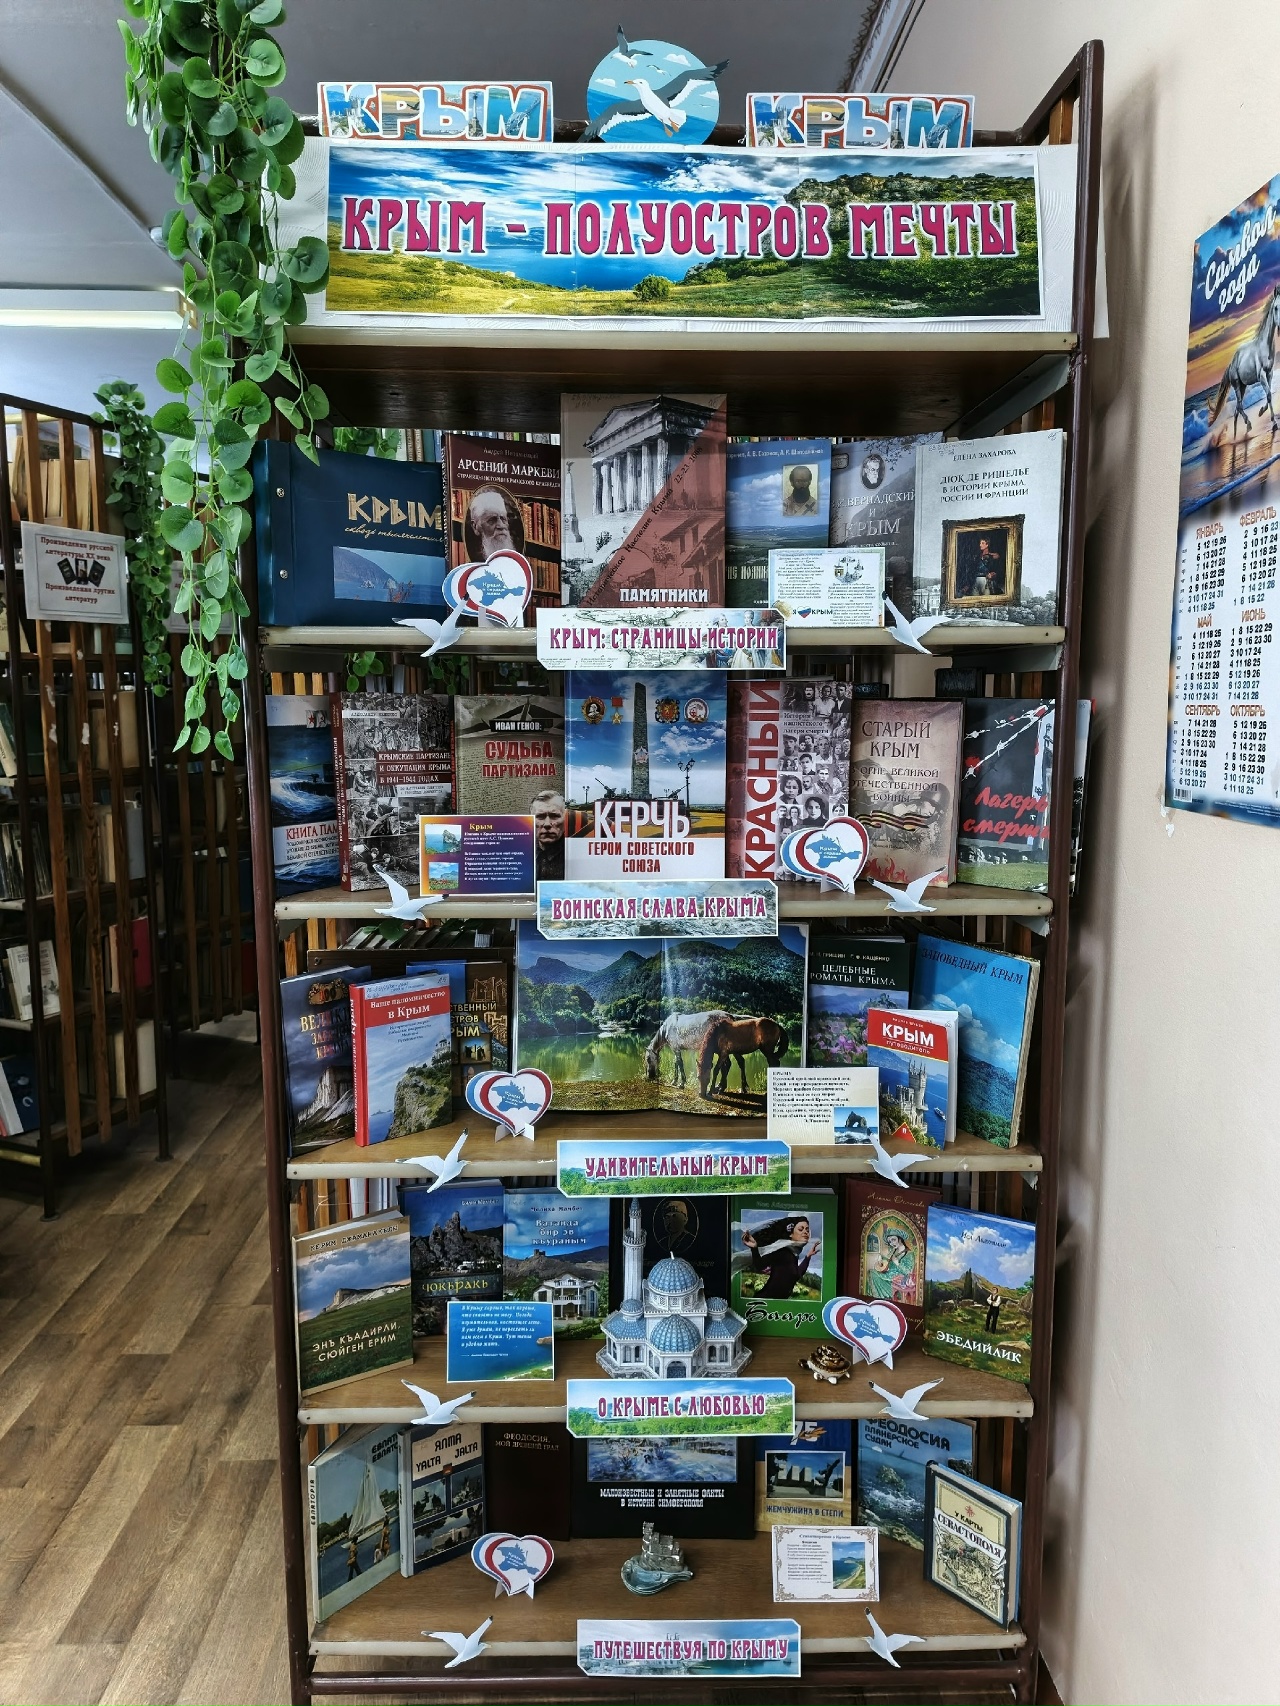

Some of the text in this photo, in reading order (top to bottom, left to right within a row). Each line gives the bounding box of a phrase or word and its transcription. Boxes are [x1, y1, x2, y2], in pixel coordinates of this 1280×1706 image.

[322, 84, 549, 139] КРЫМ
[748, 93, 972, 147] КРЫМ
[342, 197, 1017, 259] КРЫМ ПОЛУОСТРОВ МЕЧТЫ
[1205, 204, 1276, 300] Символ
[1218, 253, 1260, 313] года
[953, 449, 1017, 461] ЕЛЕНА ЗАХАРОВА
[458, 459, 508, 474] АРСЕНИЙ
[940, 468, 1030, 484] ДЮК ДЕ РИШЕЛЬЕ
[940, 494, 974, 503] РОССИИ
[984, 489, 1029, 500] ФРАНЦИИ
[942, 486, 948, 494] В
[949, 482, 991, 493] ИСТОРИИ
[347, 493, 443, 530] КРЫМ
[868, 507, 876, 517] И
[1240, 506, 1277, 527] ФЕВРАЛЬ
[843, 518, 901, 538] КРЫМ
[1196, 522, 1224, 539] ЯНВАРЬ
[620, 589, 708, 602] ПАМЯТНИКИ
[1197, 613, 1213, 628] МАЙ
[1242, 608, 1266, 622] ИЮНЬ
[550, 628, 778, 650] КРЫМ: СТРАНИЦЫ ИСТОРИИ
[1185, 704, 1220, 717] СЕНТЯБРЬ
[1230, 704, 1266, 717] ОКТЯБРЬ
[494, 720, 542, 731] ИВАН ГЕНОВ:
[862, 720, 931, 739] СТАРЫЙ
[1241, 721, 1247, 729] 12
[1250, 721, 1257, 729] 19
[1259, 721, 1266, 729] 26
[1240, 732, 1247, 740] 13
[1249, 732, 1257, 740] 20
[1259, 732, 1266, 740] 27
[485, 741, 553, 760] СУДЬБА
[870, 740, 920, 760] КРЫМ
[428, 764, 452, 772] КРЫМА
[482, 763, 556, 778] ПАРТИЗАНА
[860, 766, 939, 778] ОГНЕ ВЕЛИКОЙ
[975, 786, 1050, 819] Лагерь
[469, 823, 493, 831] Крым
[594, 801, 690, 838] КЕРЧЬ
[286, 826, 318, 840] КНИГА
[963, 818, 1050, 844] смерти
[588, 842, 694, 855] ГЕРОИ СОВЕТСКОГО
[622, 859, 661, 873] СОЮЗА
[552, 897, 766, 920] ВОИНСКАЯ СЛАВА КРЫМА
[822, 964, 876, 976] ЦЕЛЕБНЫЕ
[922, 949, 1024, 985] ЗАПОВЕДНЫЙ КРЫМ
[859, 975, 896, 986] КРЫМА
[371, 999, 390, 1009] Ваше
[392, 991, 446, 1006] паломничество
[388, 1005, 431, 1019] в Крым
[882, 1022, 934, 1048] КРЫМ
[886, 1039, 930, 1056] путеводитель
[585, 1155, 767, 1178] УДИВИТЕЛЬНЫЙ КРЫМ
[540, 1228, 559, 1236] бир
[310, 1240, 336, 1251] КЕРИМ
[422, 1280, 488, 1293] ЧОКЪРАКЪ
[312, 1340, 335, 1352] ЭНЪ
[318, 1333, 396, 1362] СЮЙГЕН ЕРИМ
[936, 1330, 1022, 1364] ЭБЕДИЙЛИК
[598, 1395, 765, 1417] О КРЫМЕ С ЛЮБОВЬЮ
[864, 1425, 919, 1449] ПЛАНЕРСКОЕ
[865, 1434, 892, 1448] СУДАК
[454, 1442, 478, 1458] JALTA
[416, 1455, 441, 1472] YALTA
[600, 1489, 654, 1497] МАЛОИЗВЕСТНЫЕ
[657, 1489, 662, 1497] И
[665, 1489, 699, 1497] ЗАНЯТНЫЕ
[620, 1499, 703, 1507] В ИСТОРИИ СИМФЕРОПОЛЯ
[766, 1505, 812, 1515] ЖЕМЧУЖИНА
[822, 1509, 844, 1518] СТЕПИ
[960, 1515, 983, 1532] КАРТЫ
[938, 1514, 1001, 1558] СЕВАСТОПОЛЯ
[594, 1639, 789, 1659] ПУТЕШЕСТВУЯ ПО КРЫМУ
